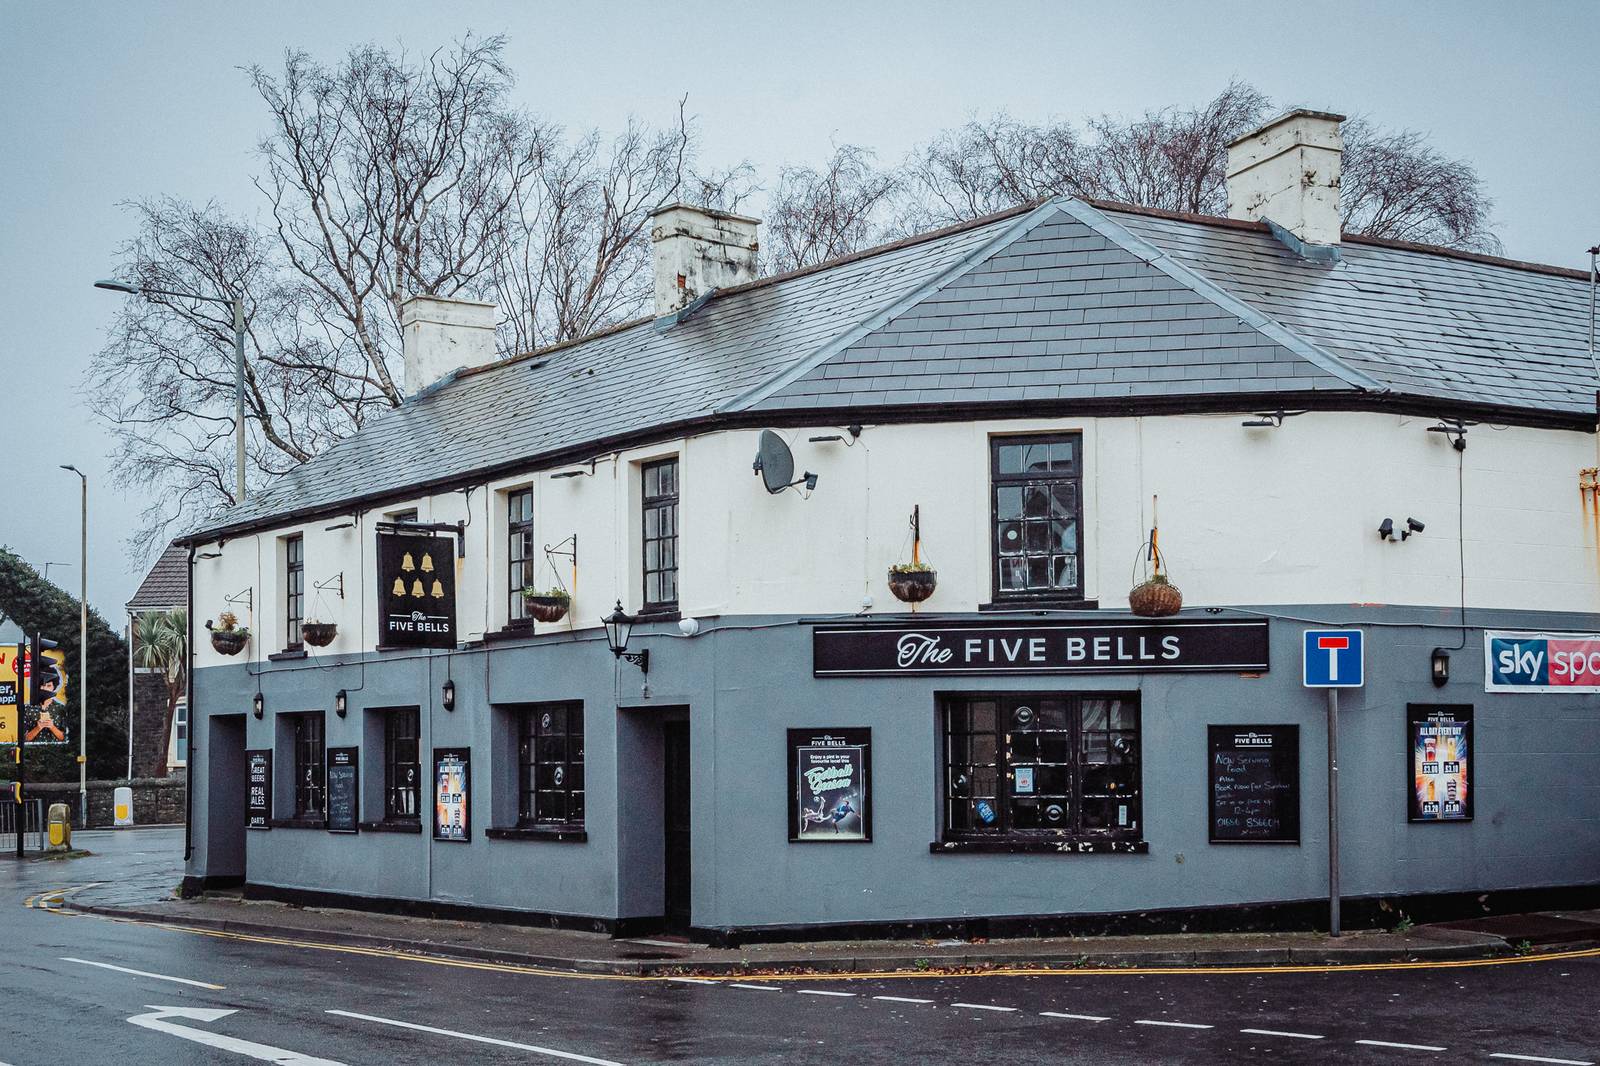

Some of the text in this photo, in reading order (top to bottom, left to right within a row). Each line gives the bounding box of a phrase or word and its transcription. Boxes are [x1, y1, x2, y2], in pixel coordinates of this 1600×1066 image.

[411, 610, 427, 621] The
[389, 621, 449, 633] FIVE BELLS
[897, 633, 1181, 667] The FIVE BELLS
[1499, 643, 1544, 681] sky
[250, 786, 265, 795] REAL
[250, 796, 265, 805] ALES
[250, 817, 265, 825] DARTS
